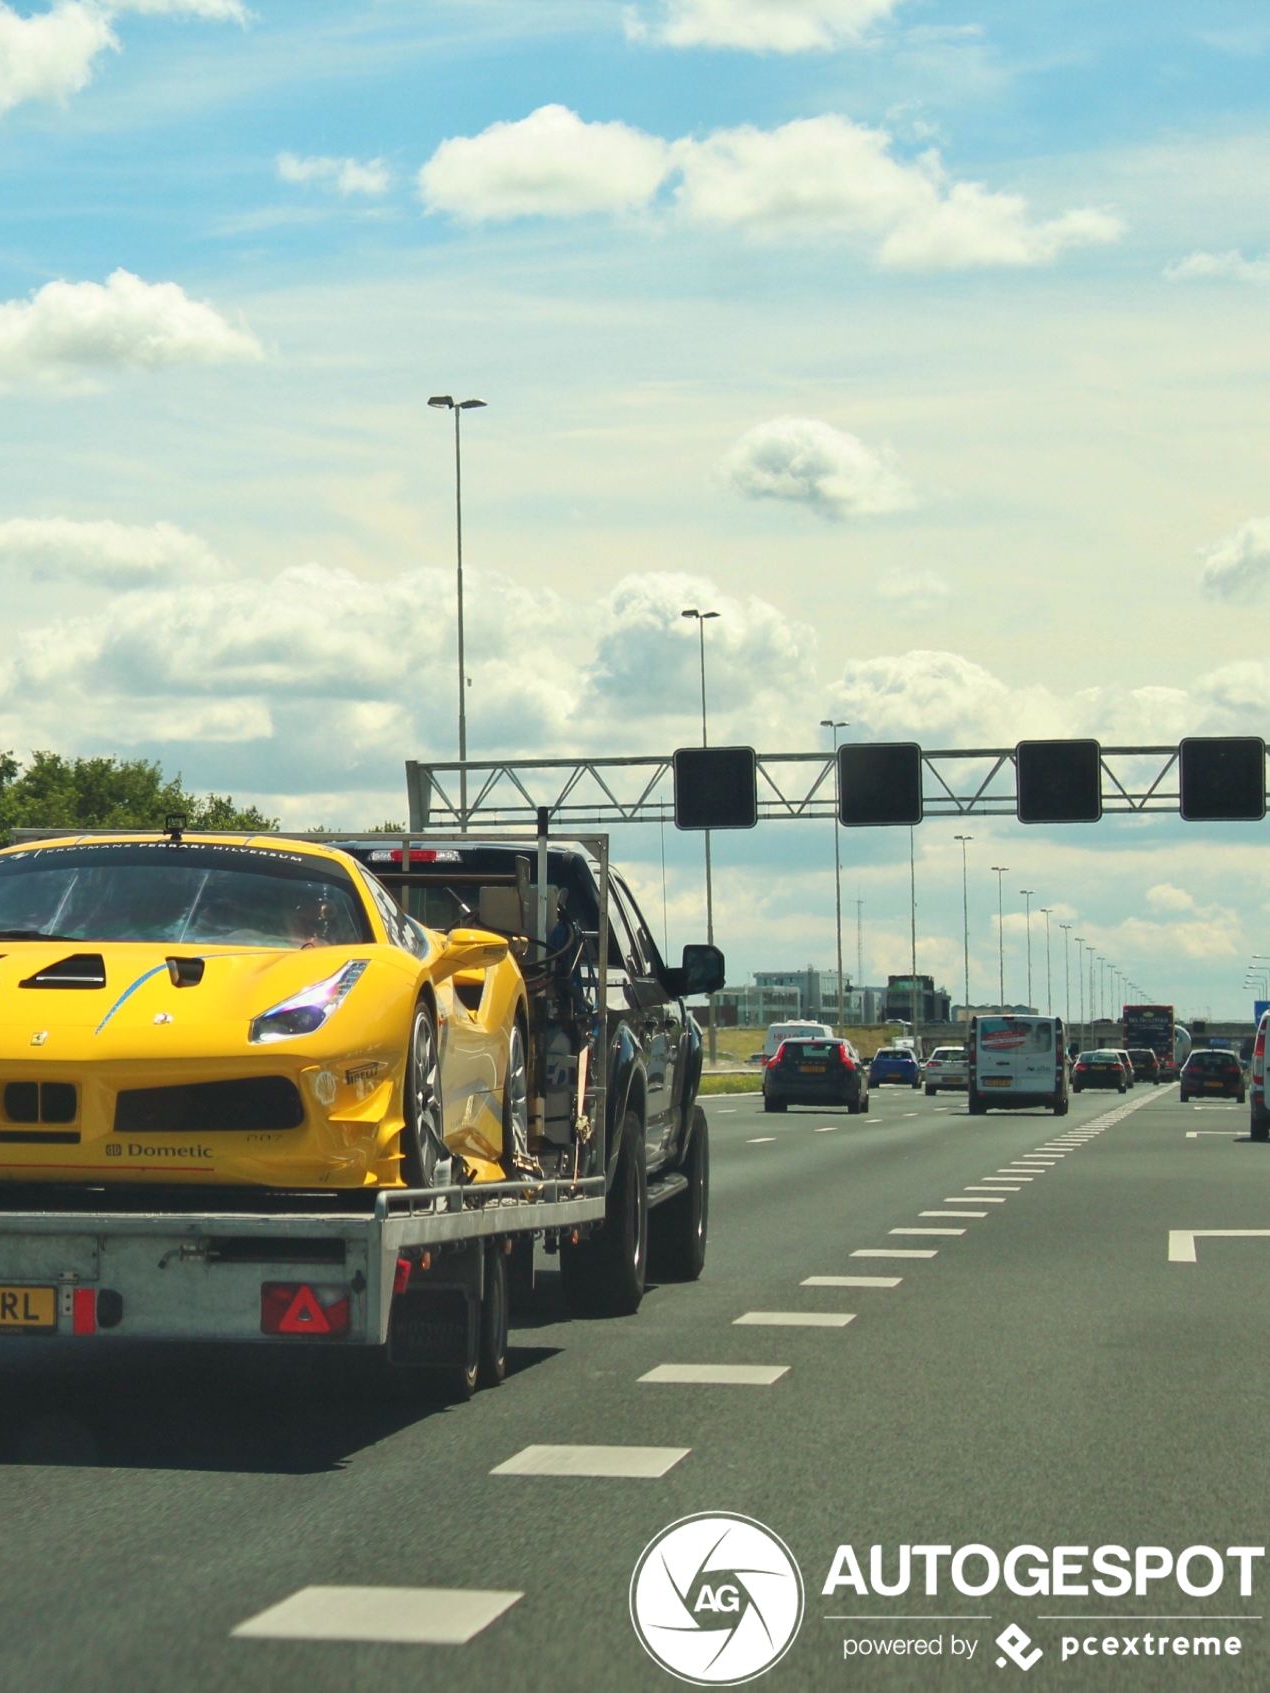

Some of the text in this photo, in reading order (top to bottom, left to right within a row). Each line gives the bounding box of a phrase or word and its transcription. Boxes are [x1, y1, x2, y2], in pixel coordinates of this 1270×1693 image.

[46, 844, 132, 854] KROYMANS
[213, 845, 303, 862] HILVERSUM
[128, 1143, 214, 1158] Dometic
